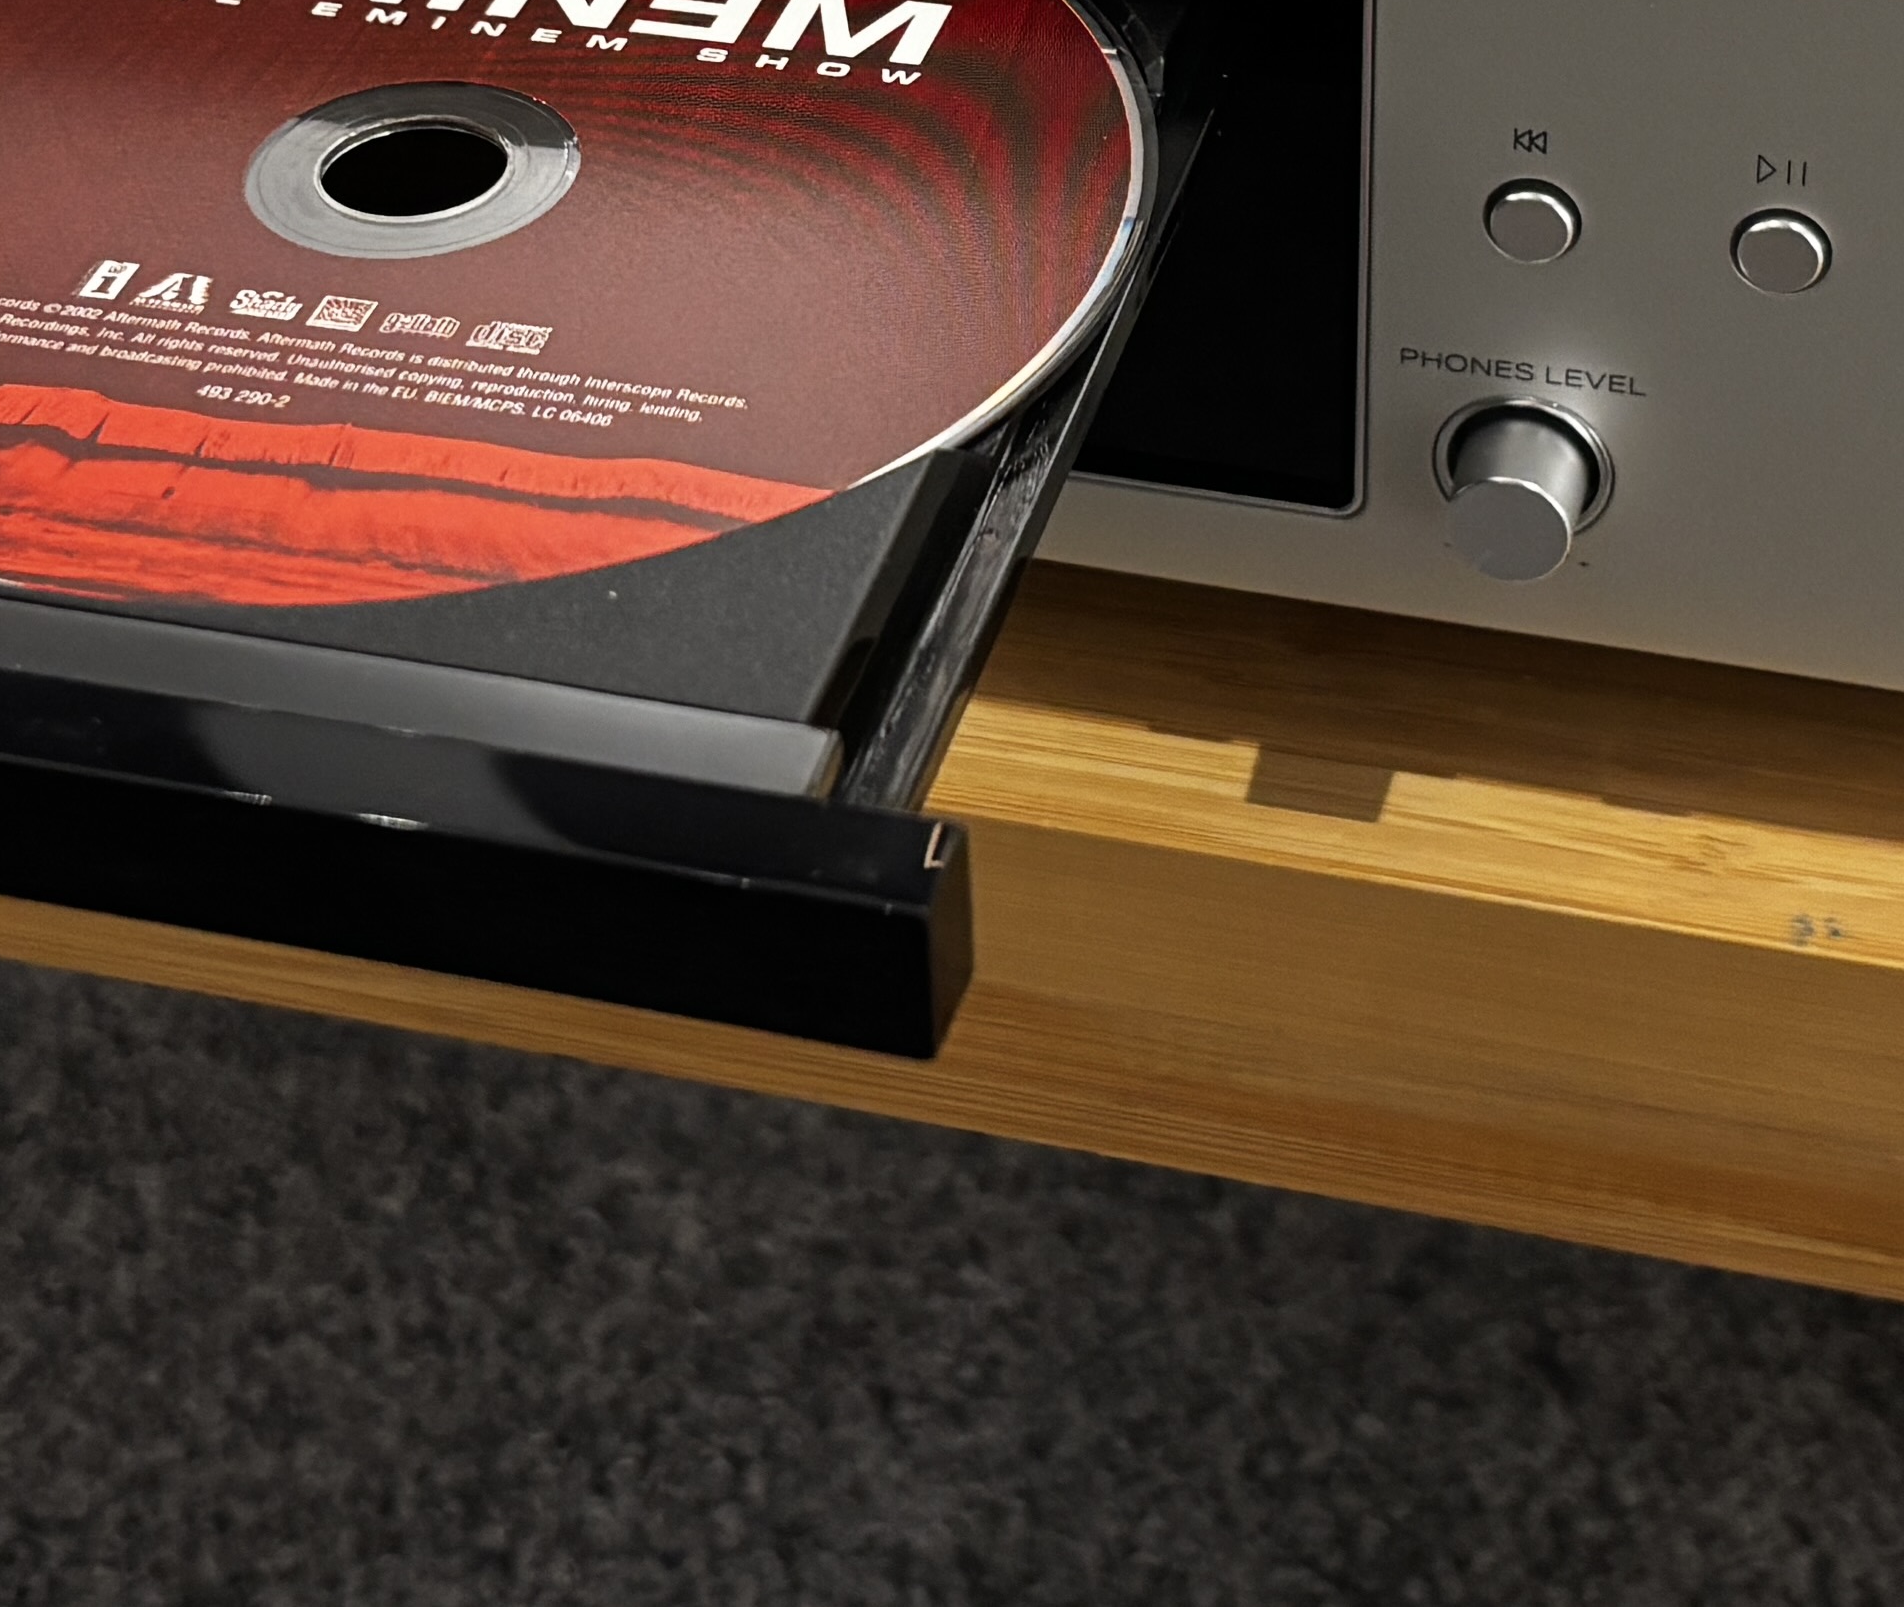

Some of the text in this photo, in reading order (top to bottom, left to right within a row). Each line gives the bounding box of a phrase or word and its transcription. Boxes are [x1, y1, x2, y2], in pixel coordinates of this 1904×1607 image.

[310, 1, 629, 51] EMINEM
[696, 47, 922, 85] SHOW
[65, 340, 100, 356] and
[99, 345, 203, 372] broadcasting
[203, 361, 289, 383] prohibited.
[293, 372, 340, 390] Made
[342, 380, 360, 393] in
[361, 383, 389, 397] the
[390, 385, 419, 400] EU.
[531, 404, 556, 420] LC
[103, 310, 183, 331] Aftermath
[256, 332, 336, 353] Aftermath
[338, 342, 406, 362] Records
[408, 352, 423, 365] is
[427, 355, 515, 377] distributed
[516, 366, 581, 387] through
[676, 388, 749, 410] Records.
[130, 331, 156, 345] All
[156, 334, 206, 353] rights
[207, 344, 282, 363] reserved.
[286, 353, 397, 380] Unauthorised
[398, 369, 465, 391] copying,
[1399, 346, 1647, 397] PHONES LEVEL
[195, 384, 291, 409] 493 290-2
